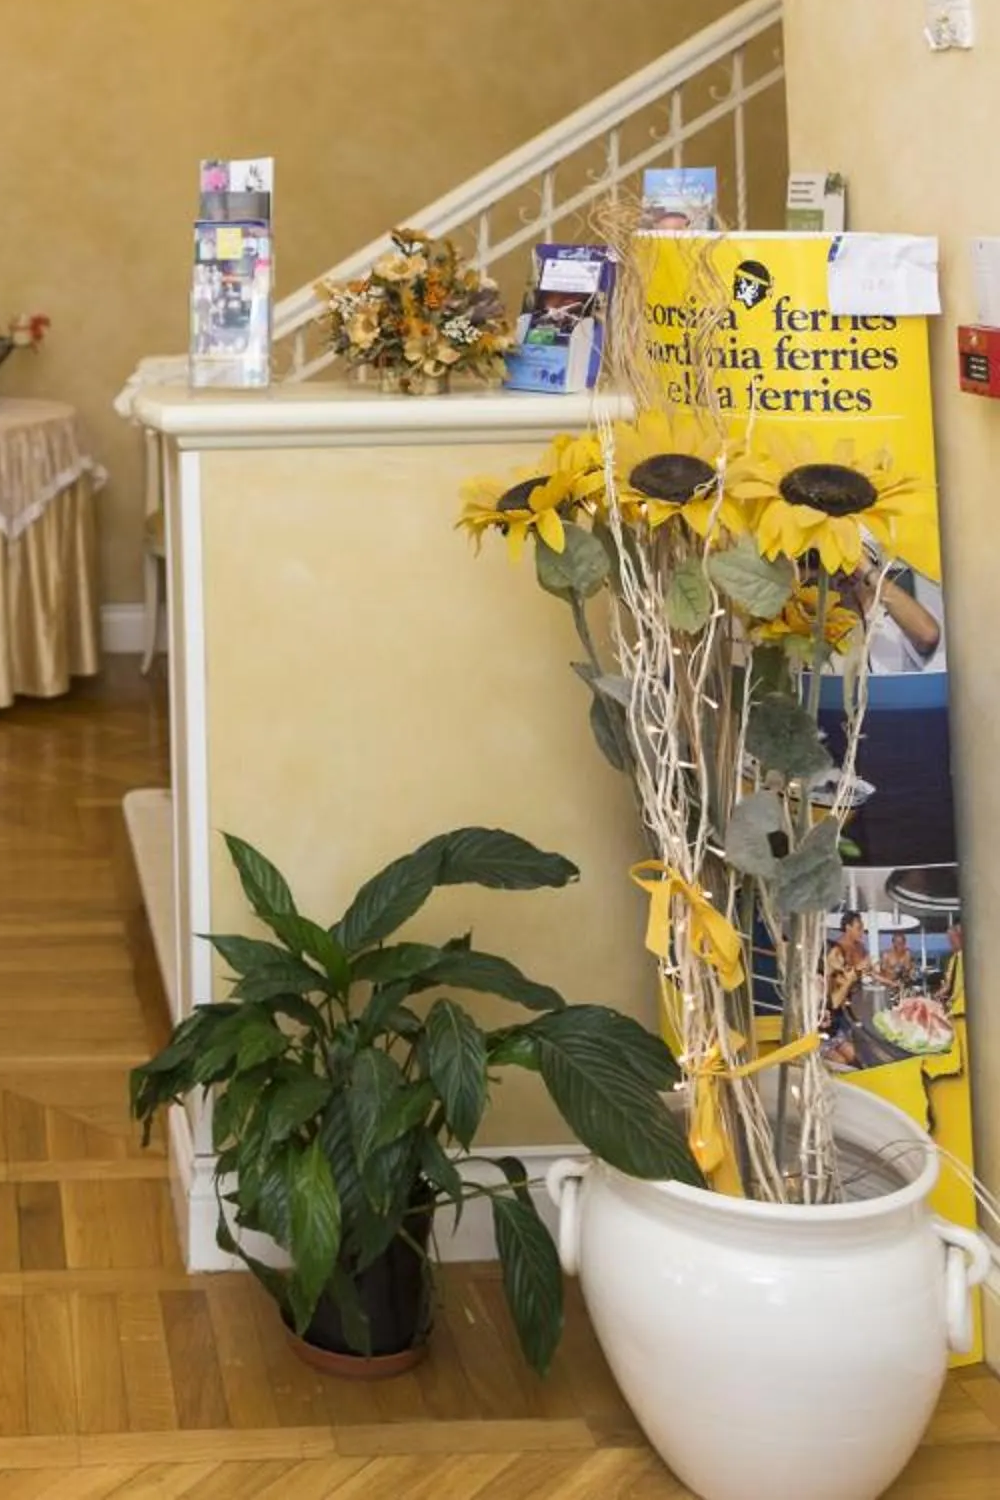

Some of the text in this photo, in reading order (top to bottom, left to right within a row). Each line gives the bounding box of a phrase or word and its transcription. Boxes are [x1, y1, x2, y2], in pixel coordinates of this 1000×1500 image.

[644, 296, 738, 330] corsia
[645, 332, 898, 371] ardnia ferries
[667, 371, 873, 412] ela ferries
